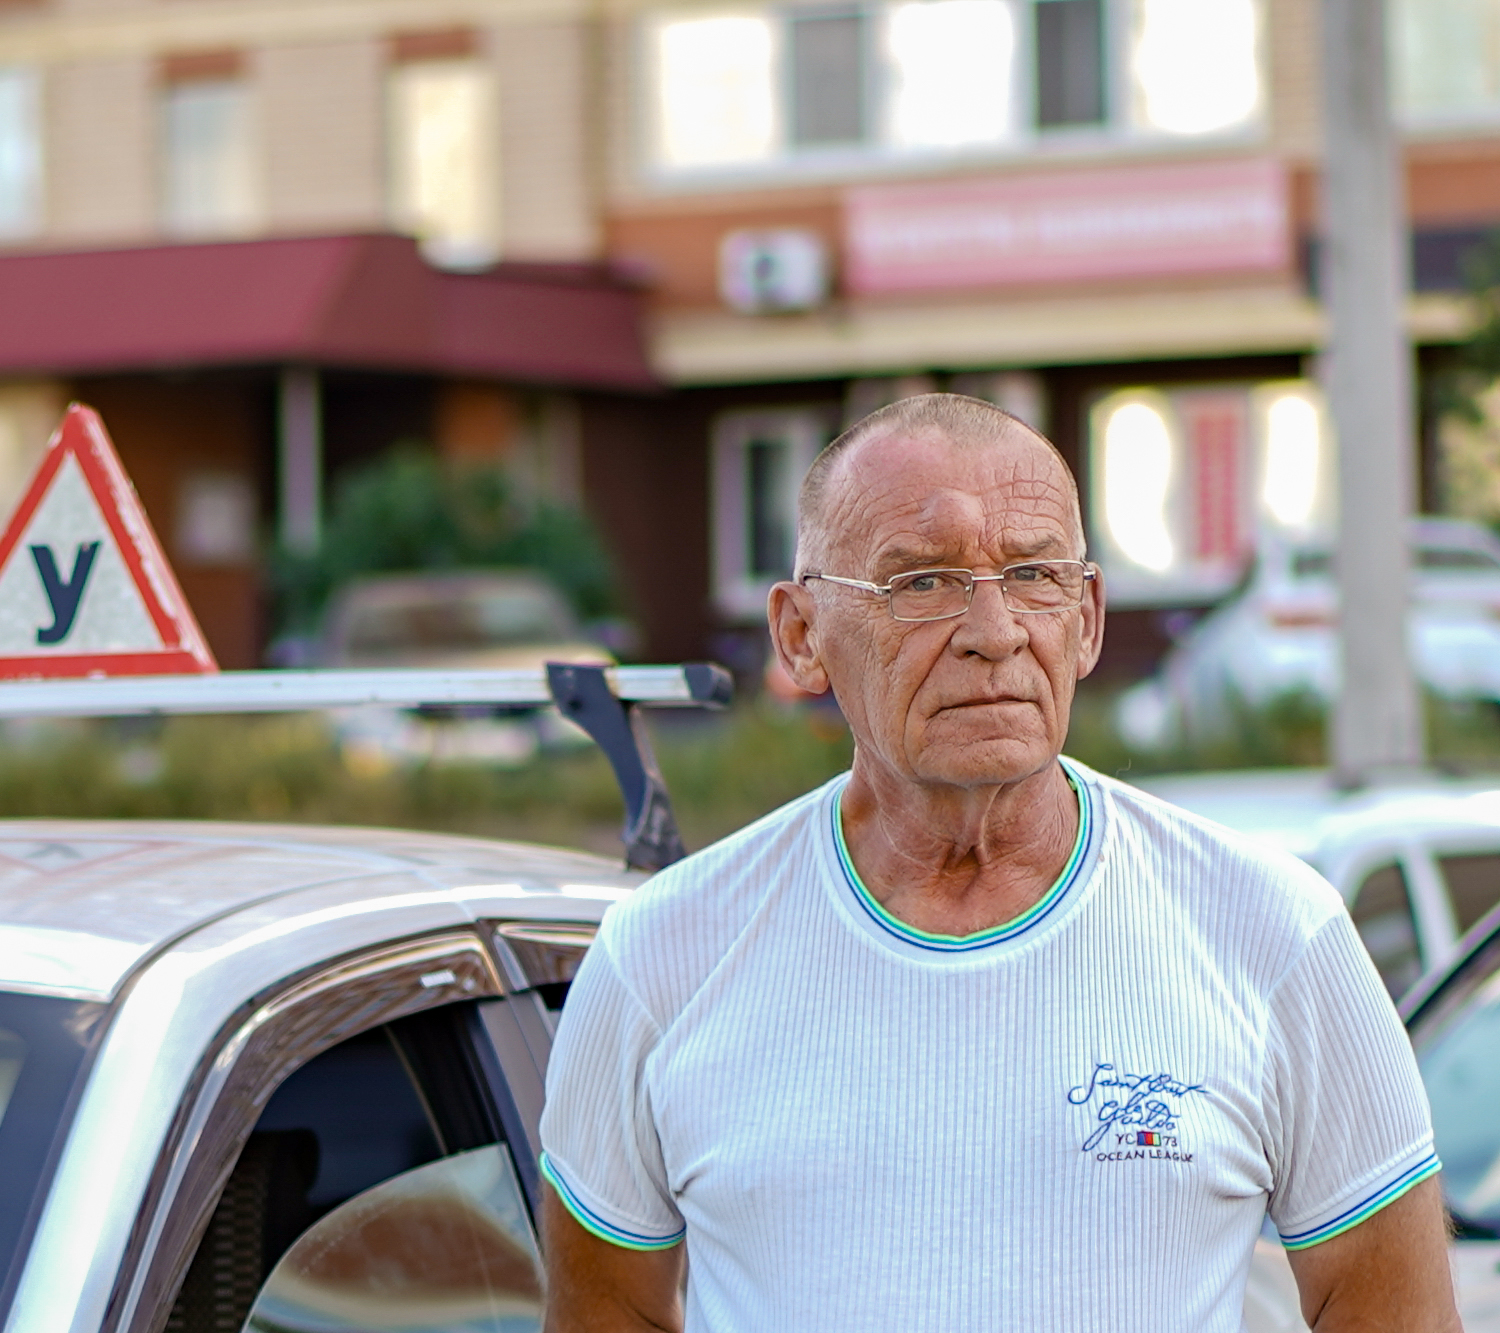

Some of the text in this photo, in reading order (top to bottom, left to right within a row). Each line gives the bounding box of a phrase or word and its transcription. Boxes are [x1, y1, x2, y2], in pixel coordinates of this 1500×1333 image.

[30, 541, 101, 646] У
[1115, 1133, 1136, 1145] YC
[1162, 1136, 1178, 1147] 73
[1096, 1150, 1145, 1162] OCEAN
